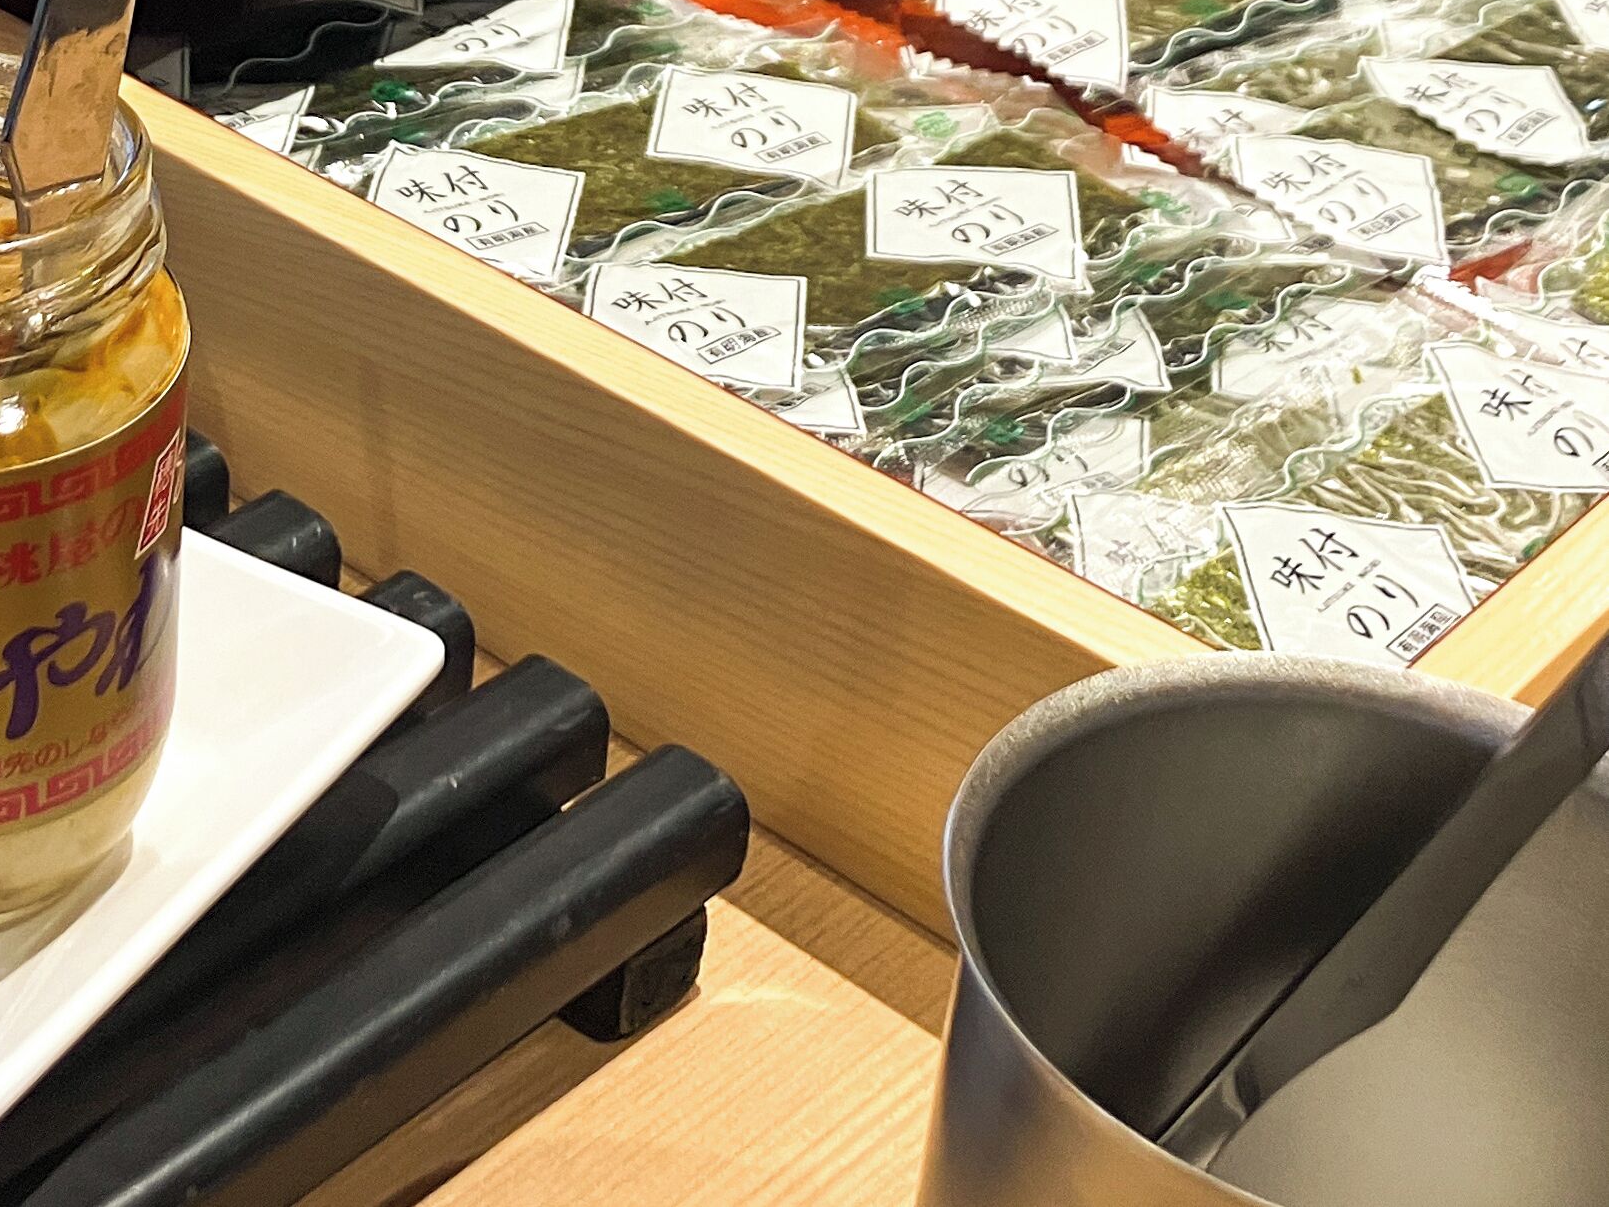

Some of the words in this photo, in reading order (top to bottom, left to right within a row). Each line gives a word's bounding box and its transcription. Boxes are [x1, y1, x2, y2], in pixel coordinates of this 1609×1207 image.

[454, 23, 521, 52] のり
[681, 82, 769, 118] 味付
[1464, 90, 1528, 133] のり
[730, 110, 803, 148] のり
[395, 165, 489, 204] 味付
[1261, 150, 1348, 193] 味付
[443, 199, 520, 234] のり
[894, 179, 985, 219] 味付
[1318, 177, 1389, 223] のり
[952, 204, 1026, 244] のり
[611, 278, 709, 313] 味付
[667, 305, 747, 344] のり
[1479, 368, 1559, 422] 味付
[1270, 527, 1360, 594] 味付
[1347, 574, 1420, 639] のり
